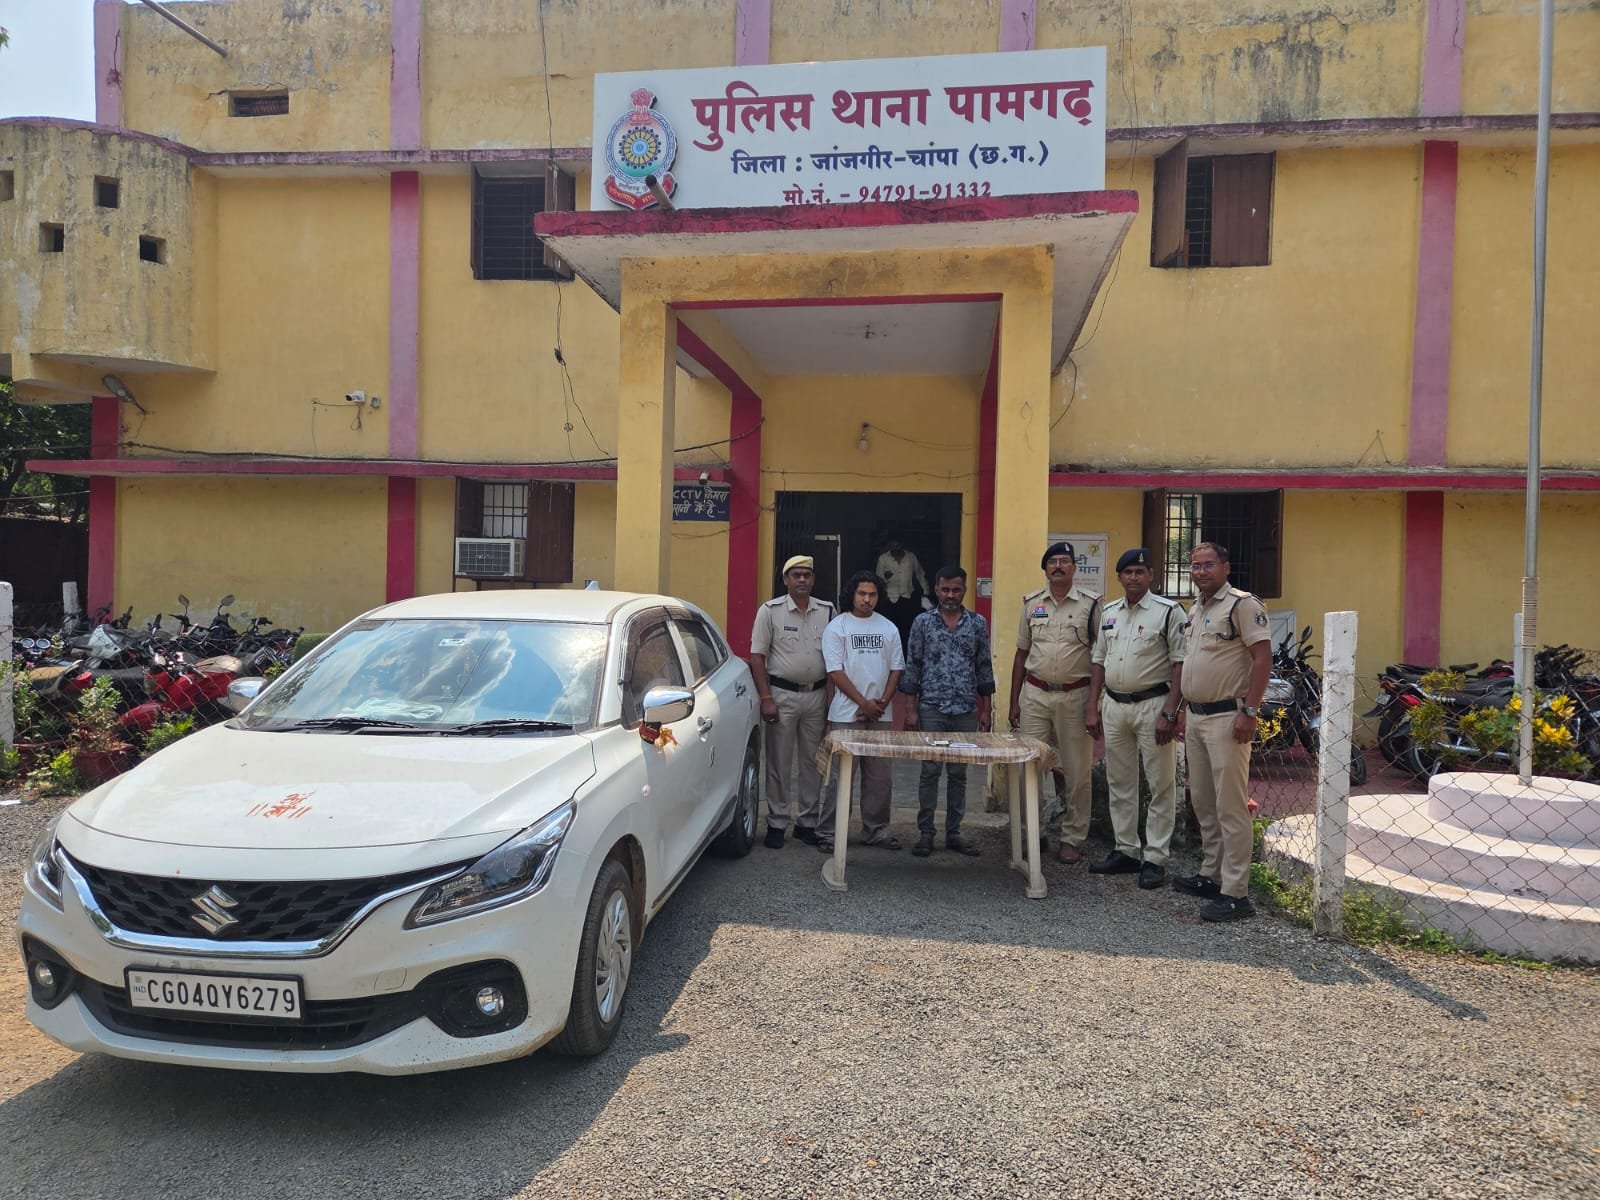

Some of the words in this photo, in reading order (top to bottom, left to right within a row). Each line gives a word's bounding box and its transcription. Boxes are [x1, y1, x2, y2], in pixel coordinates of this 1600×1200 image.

[690, 80, 815, 151] पुलिस
[832, 88, 931, 128] थाना
[944, 80, 1095, 126] पामगढ़
[730, 149, 786, 174] जिला
[859, 181, 991, 203] 94791-91332
[147, 979, 295, 1012] CG04QY6279
